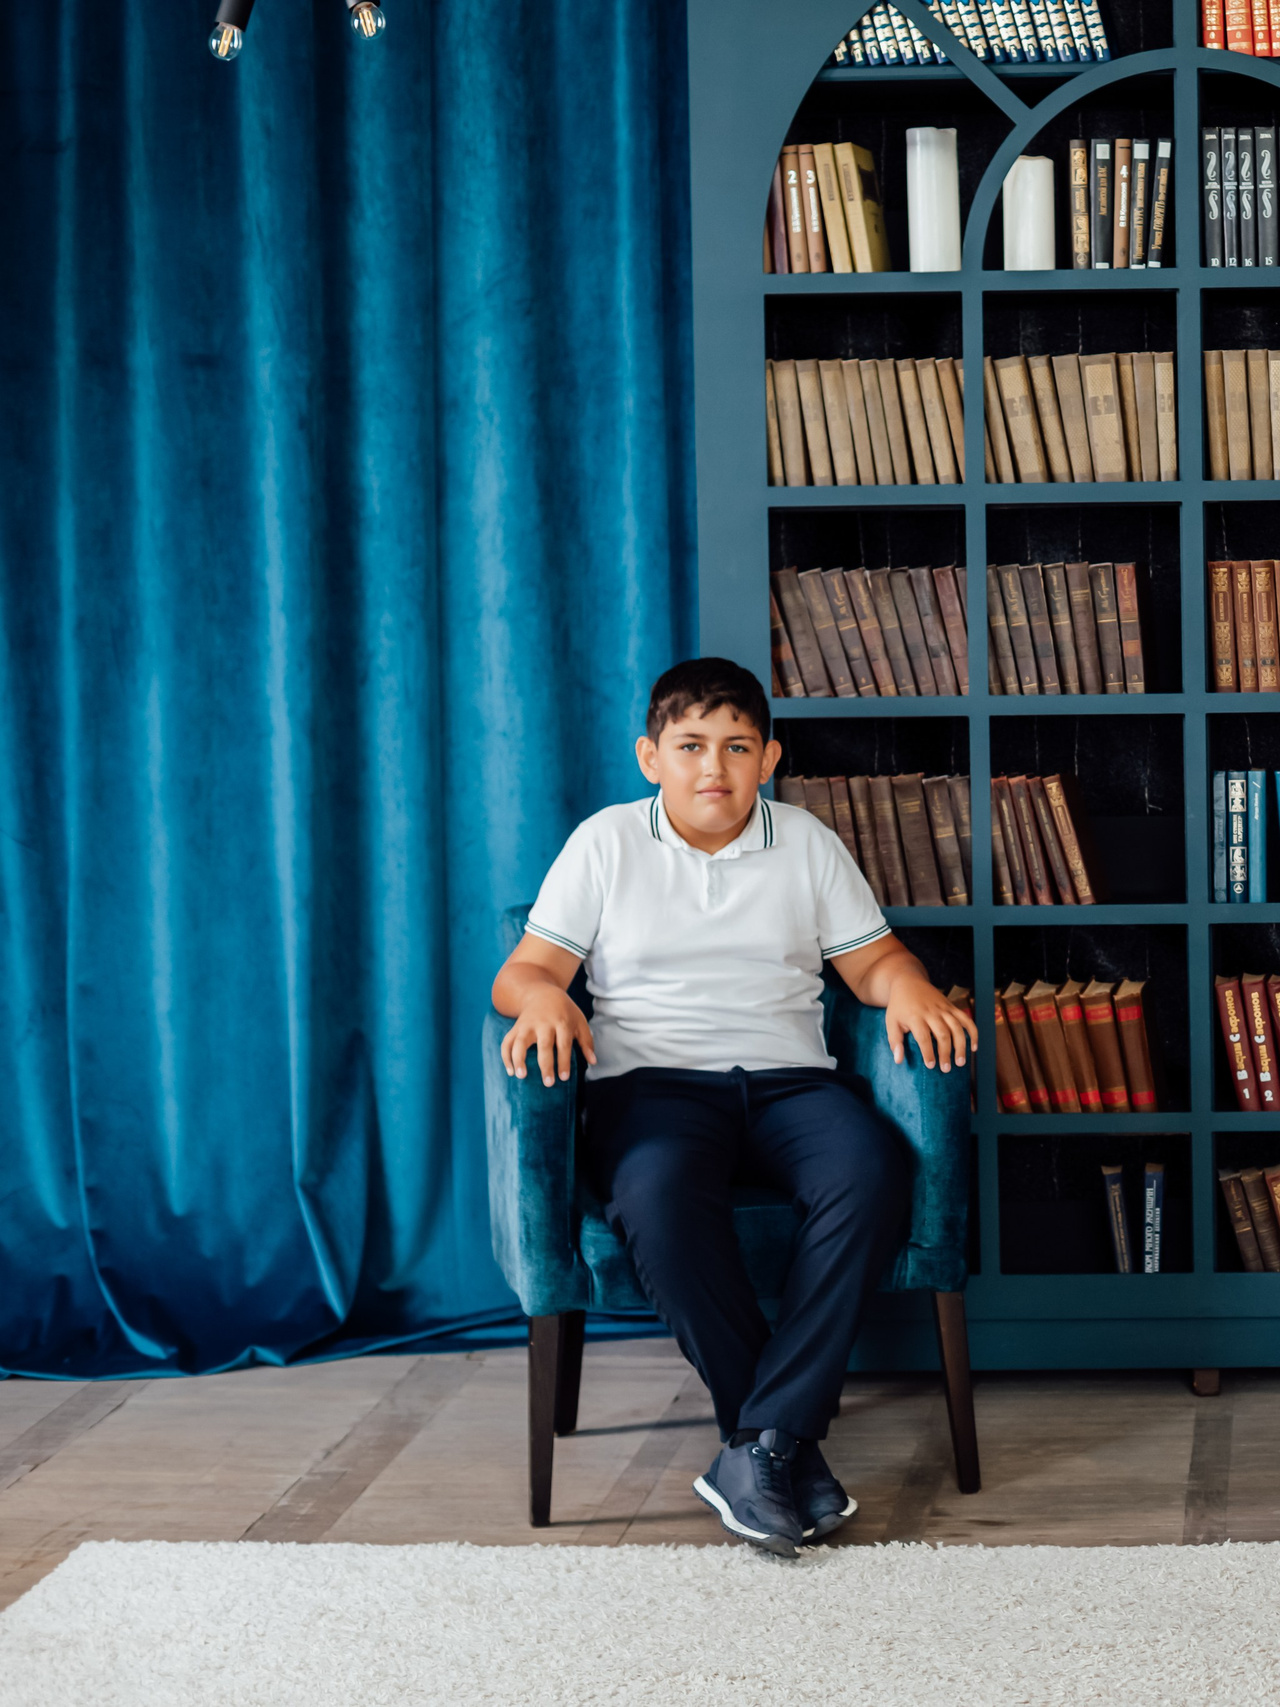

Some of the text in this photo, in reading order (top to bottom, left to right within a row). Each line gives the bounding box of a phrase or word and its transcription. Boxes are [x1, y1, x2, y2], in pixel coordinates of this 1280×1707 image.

[788, 170, 798, 184] 2
[806, 170, 816, 184] 3
[1120, 165, 1128, 178] 4
[1211, 258, 1220, 266] 10
[1229, 258, 1237, 266] 12
[1244, 258, 1252, 266] 16
[1265, 256, 1273, 266] 15
[1243, 1088, 1250, 1099] 1
[1264, 1090, 1274, 1102] 2
[1144, 1188, 1154, 1274] КОМ МНОГО ЖЕНЩИН
